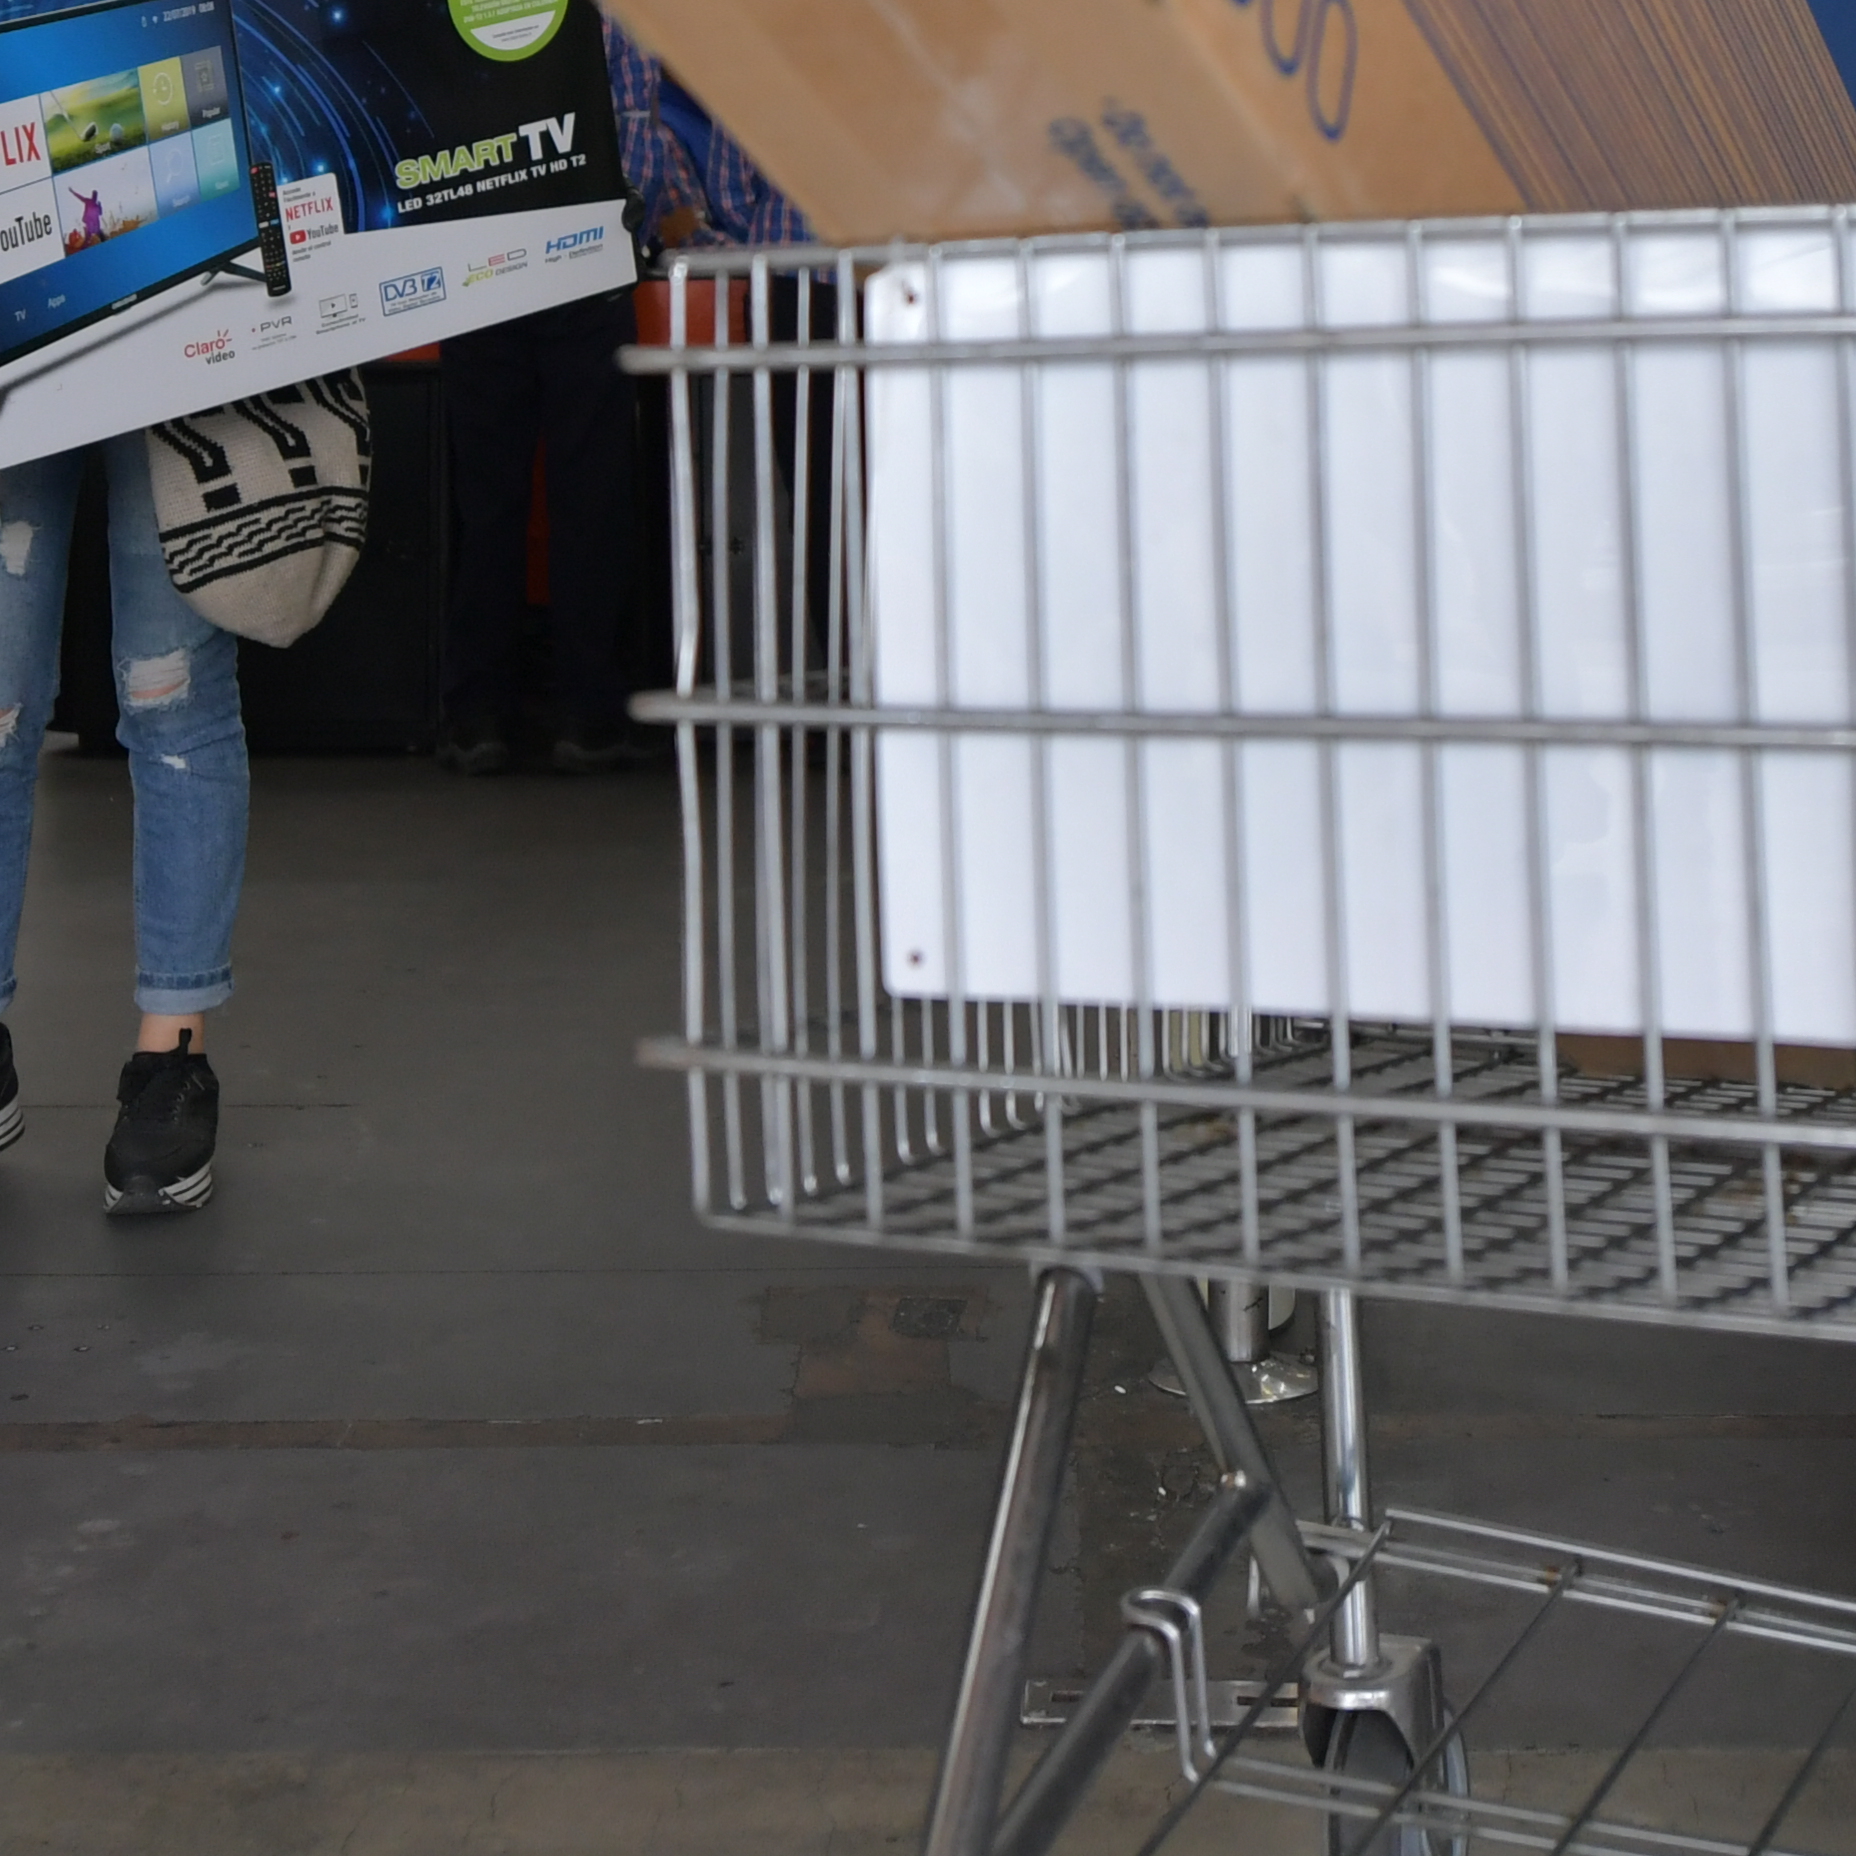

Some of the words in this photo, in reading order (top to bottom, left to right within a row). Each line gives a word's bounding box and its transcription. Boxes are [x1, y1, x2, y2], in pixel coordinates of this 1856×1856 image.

[396, 132, 517, 189] SMART
[518, 112, 575, 161] TV
[397, 197, 423, 213] LED
[426, 184, 474, 206] 32TL48
[476, 169, 528, 192] NETFLIX
[531, 164, 547, 178] TV
[550, 158, 567, 173] HD
[570, 154, 586, 168] T2
[286, 197, 333, 222] NETFLIX
[307, 224, 338, 240] YouTube
[545, 226, 604, 254] HDMI
[468, 248, 527, 272] LED
[467, 269, 493, 284] ECO
[495, 261, 528, 276] DESIGN
[383, 278, 417, 303] DVB
[421, 271, 441, 292] T2
[15, 309, 26, 322] TV
[47, 294, 66, 309] Apps
[260, 315, 292, 333] PVR
[184, 338, 226, 358] Claro
[205, 350, 235, 365] video
